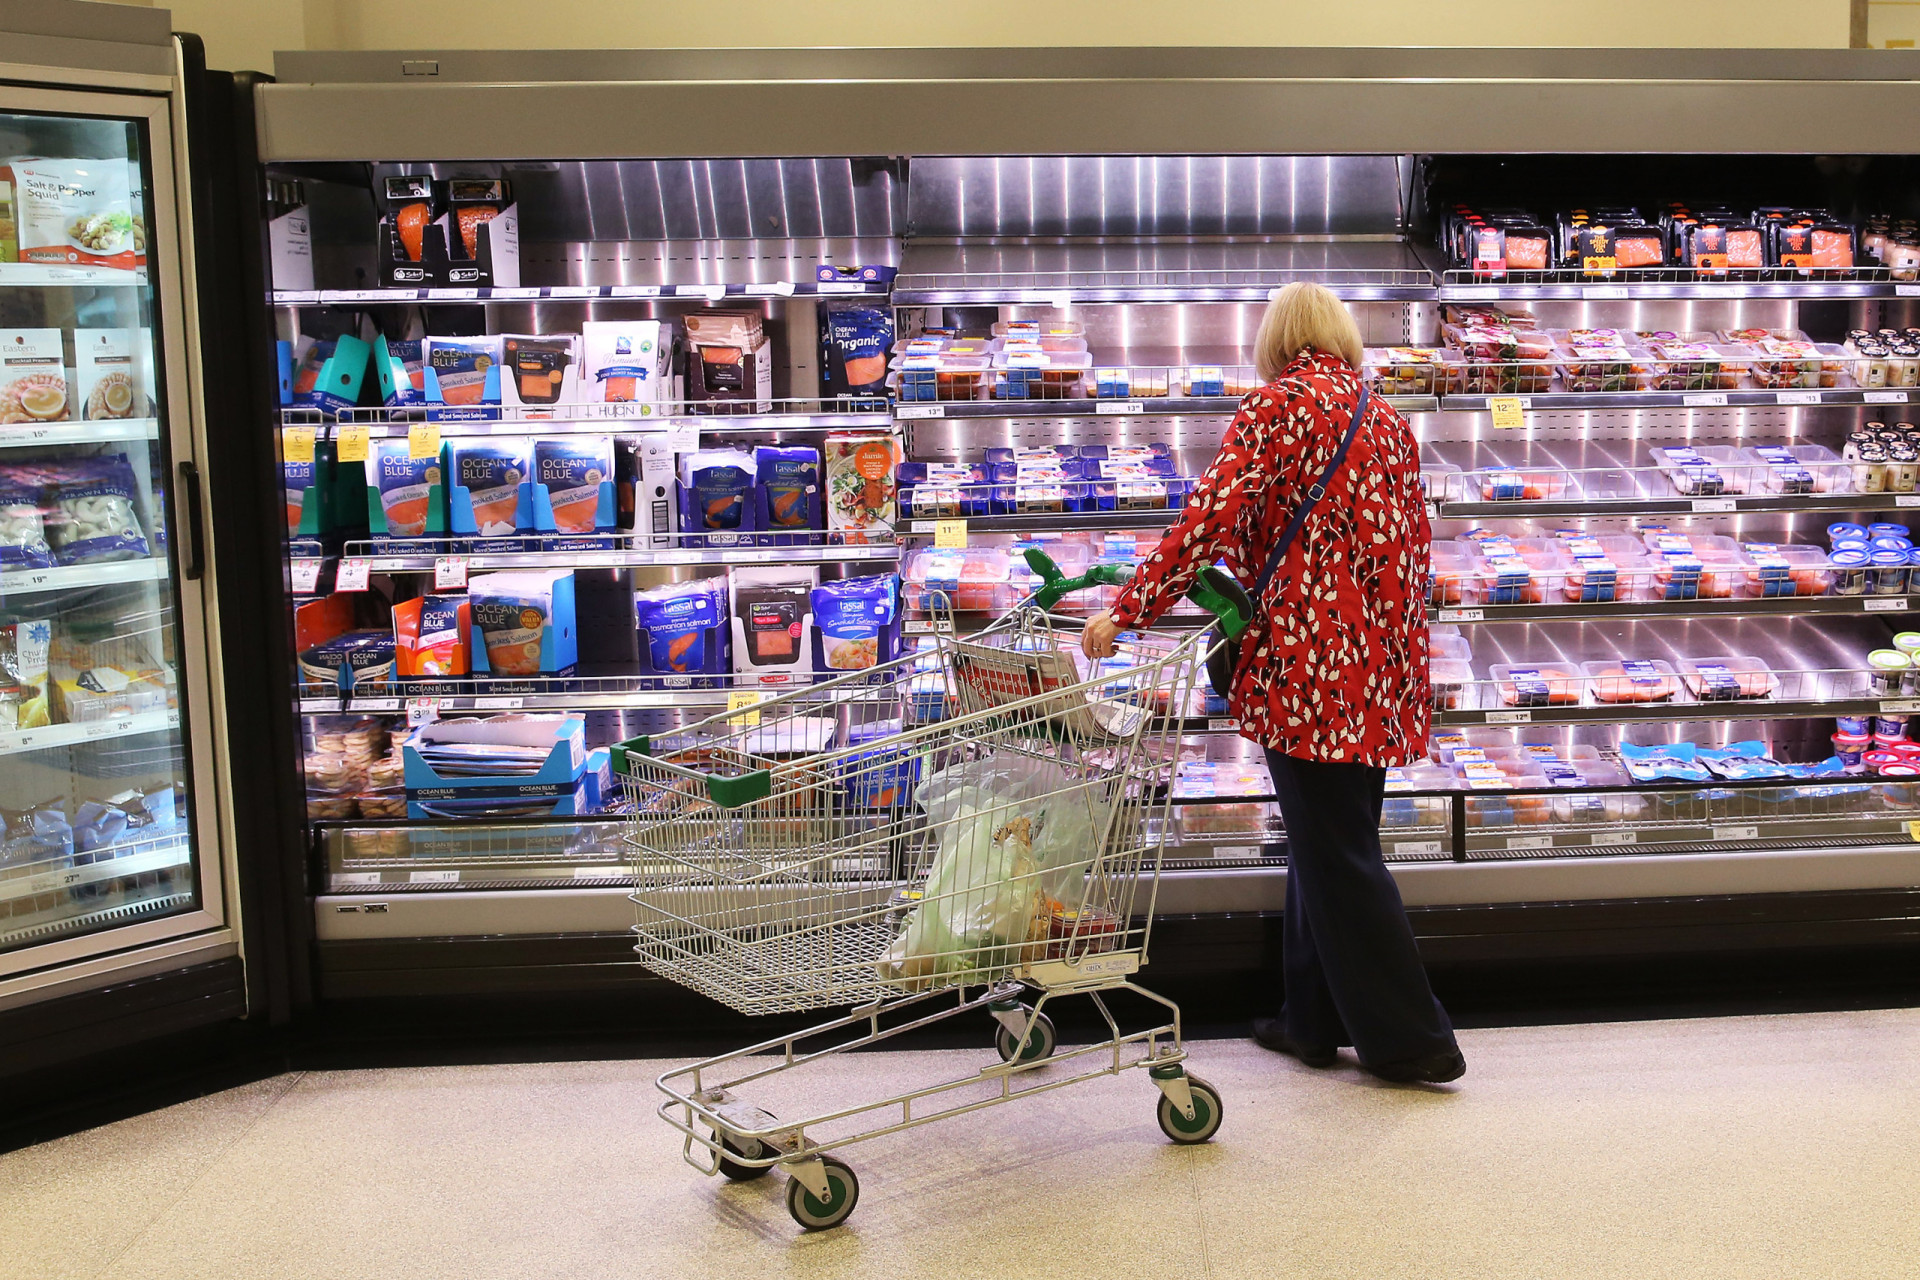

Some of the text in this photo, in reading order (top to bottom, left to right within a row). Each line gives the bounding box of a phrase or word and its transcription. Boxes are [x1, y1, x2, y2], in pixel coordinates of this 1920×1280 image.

[26, 179, 47, 190] Salt
[48, 183, 57, 192] &
[27, 188, 60, 200] Squid
[837, 334, 880, 351] Organic
[2, 344, 37, 353] Eastern
[433, 348, 473, 359] OCEAN
[433, 357, 459, 367] BLUE
[440, 377, 465, 389] Smoked
[599, 405, 635, 416] HUON
[383, 455, 427, 465] OCEAN
[862, 452, 884, 460] Jamie
[462, 458, 507, 469] OCEAN
[542, 458, 588, 469] OCEAN
[385, 466, 413, 476] BLUE
[463, 468, 493, 479] BLUE
[543, 469, 573, 480] BLUE
[64, 487, 129, 499] PRAWN MEAT
[472, 488, 518, 506] moked Salmon
[574, 488, 599, 501] Salmon
[475, 603, 520, 615] OCEAN
[424, 610, 455, 620] OCEAN
[477, 613, 505, 625] BLUE
[423, 619, 446, 627] BLUE
[650, 621, 686, 632] tasmanian
[686, 618, 711, 627] salmon
[827, 616, 880, 628] Smoked Salmon
[488, 631, 538, 646] moked Salmon
